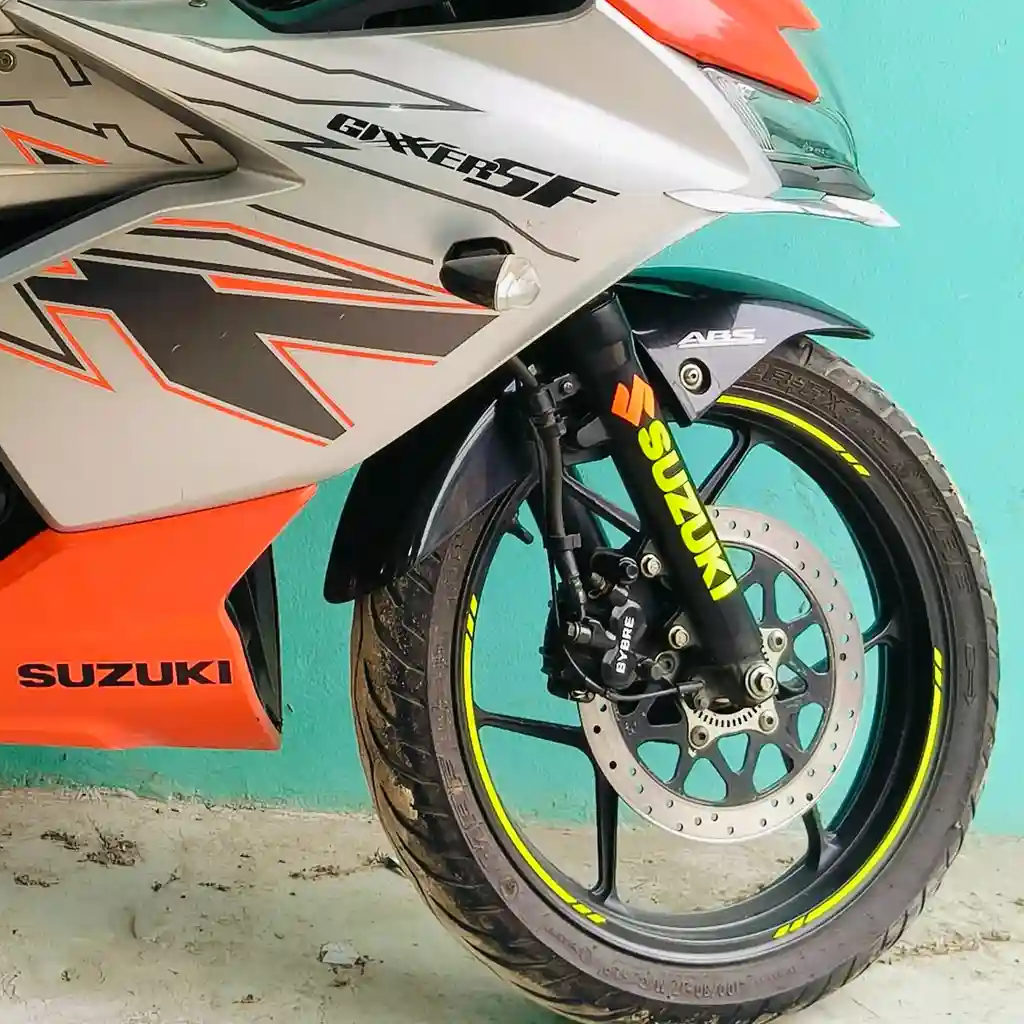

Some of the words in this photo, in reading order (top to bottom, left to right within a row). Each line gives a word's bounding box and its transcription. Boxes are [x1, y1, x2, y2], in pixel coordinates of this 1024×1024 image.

[677, 328, 762, 348] ABS
[637, 419, 738, 601] SUZUKI
[615, 616, 635, 674] BYBRE
[17, 660, 233, 688] SUZUKI
